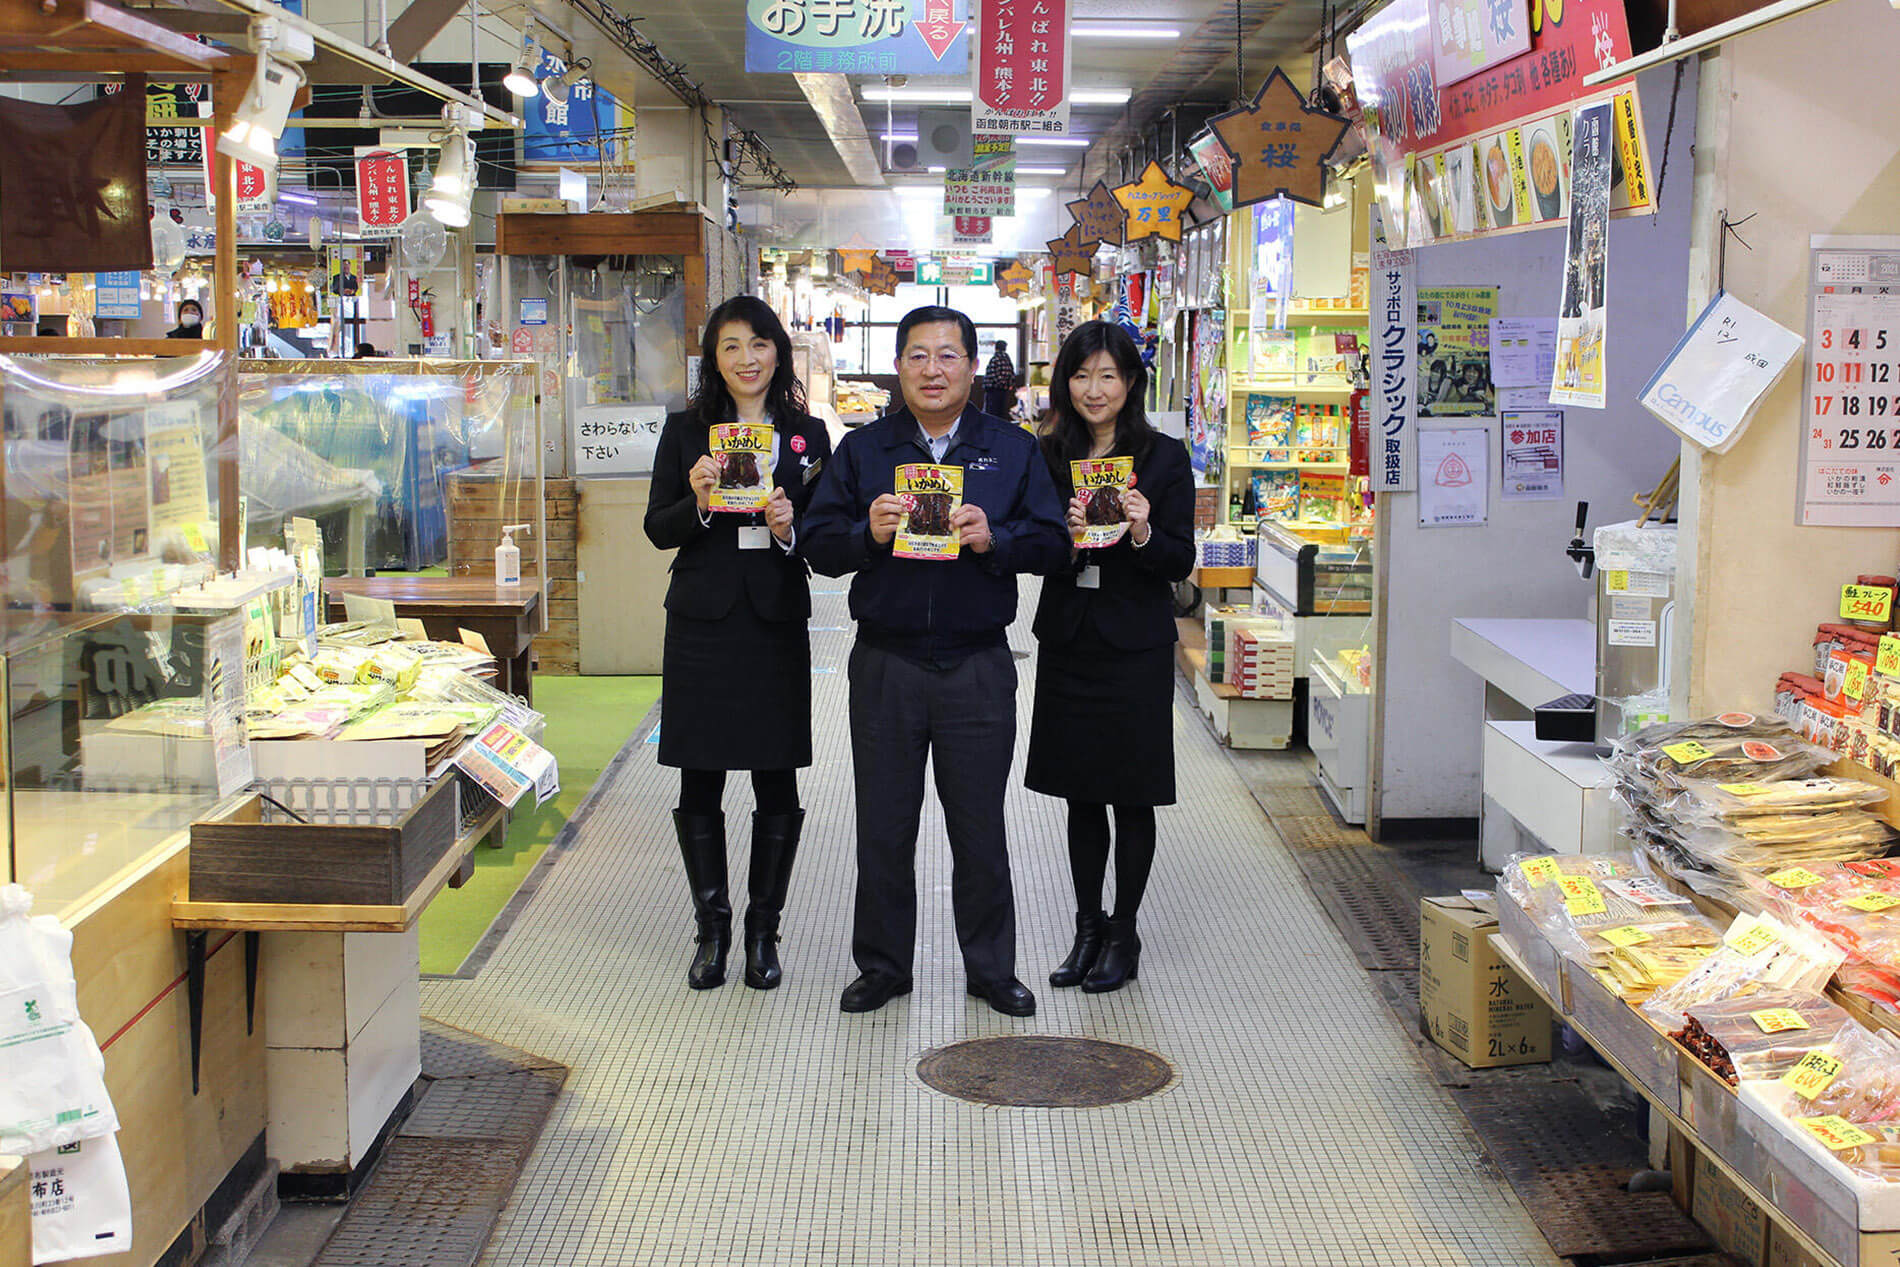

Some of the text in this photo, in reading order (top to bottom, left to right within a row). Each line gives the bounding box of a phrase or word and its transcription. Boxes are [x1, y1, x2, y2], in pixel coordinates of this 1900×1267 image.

[777, 51, 897, 71] 2階事務所前
[995, 0, 1014, 106] バレ九州・熊本!!
[976, 118, 1063, 133] 函館朝市駅二組合
[1260, 143, 1299, 169] 桜
[947, 171, 1014, 182] 北海道新幹線
[1136, 206, 1172, 222] 万里
[1821, 329, 1887, 349] 3 4 5
[1382, 271, 1406, 485] サッポロクラシック取扱店
[1816, 363, 1890, 383] 10 11 12
[1658, 383, 1727, 438] Campus
[1814, 396, 1888, 416] 17 18 19
[580, 421, 658, 437] さわらないで
[1510, 430, 1556, 444] 参加店
[1813, 429, 1887, 449] 24 25 26
[582, 445, 619, 460] 下さい
[720, 437, 762, 449] いかめし
[1824, 439, 1832, 449] 31
[907, 479, 951, 492] いかめし
[1083, 471, 1124, 485] いかめし
[1489, 976, 1510, 997] 水
[33, 1178, 64, 1198] 布店
